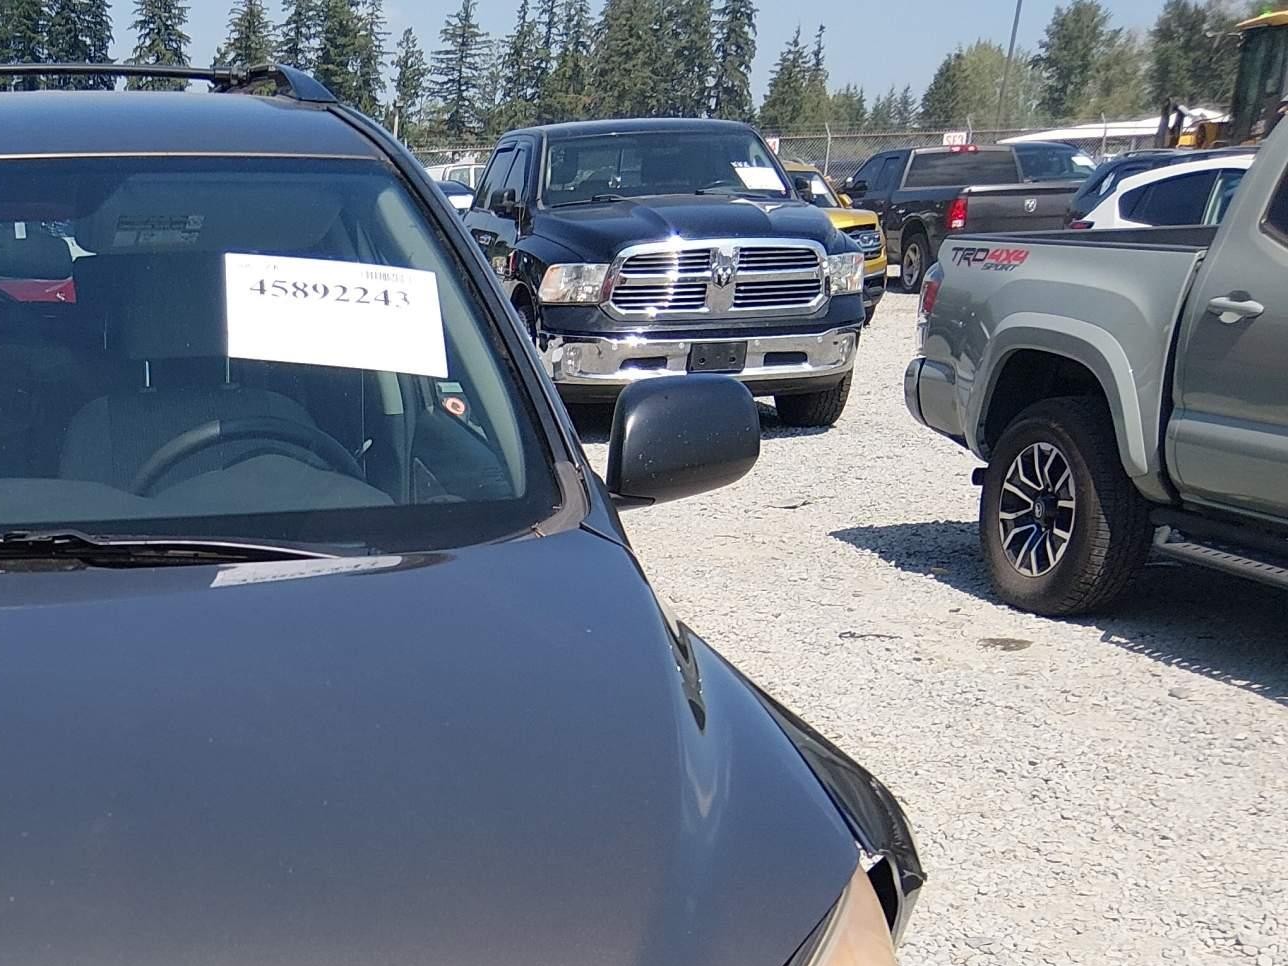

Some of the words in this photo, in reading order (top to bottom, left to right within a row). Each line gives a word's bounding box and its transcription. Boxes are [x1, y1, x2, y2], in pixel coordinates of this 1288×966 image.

[951, 246, 990, 267] TRD
[980, 262, 1019, 272] SPORT
[249, 278, 411, 308] 45892243
